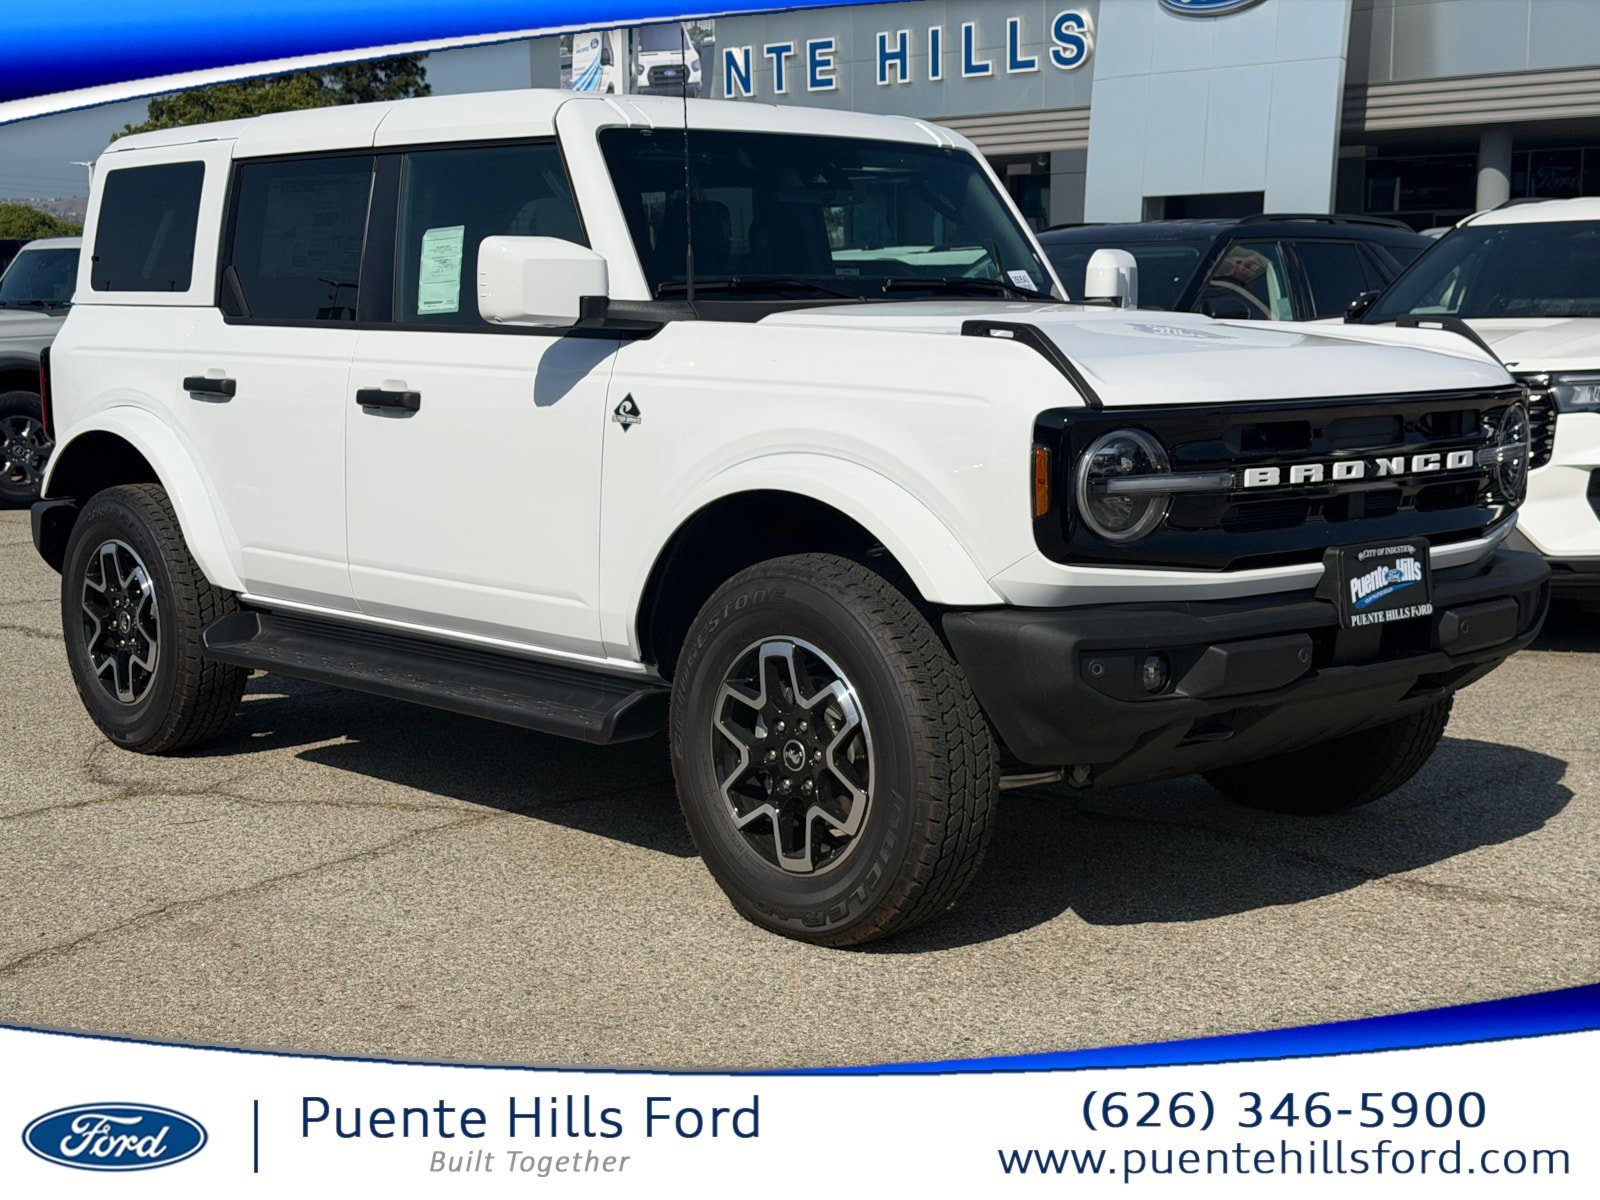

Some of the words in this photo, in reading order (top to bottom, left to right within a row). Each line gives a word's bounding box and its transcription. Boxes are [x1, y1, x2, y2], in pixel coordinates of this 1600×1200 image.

[722, 36, 838, 98] NTE
[876, 9, 1095, 86] HILLS
[1243, 449, 1474, 488] BRONCO
[1363, 548, 1376, 558] CITY
[1377, 547, 1385, 556] OF
[1350, 565, 1388, 604] Puente
[1395, 557, 1422, 582] Hills
[1351, 610, 1385, 627] PUENTE
[1385, 606, 1411, 622] HILLS
[1411, 603, 1433, 618] FORD
